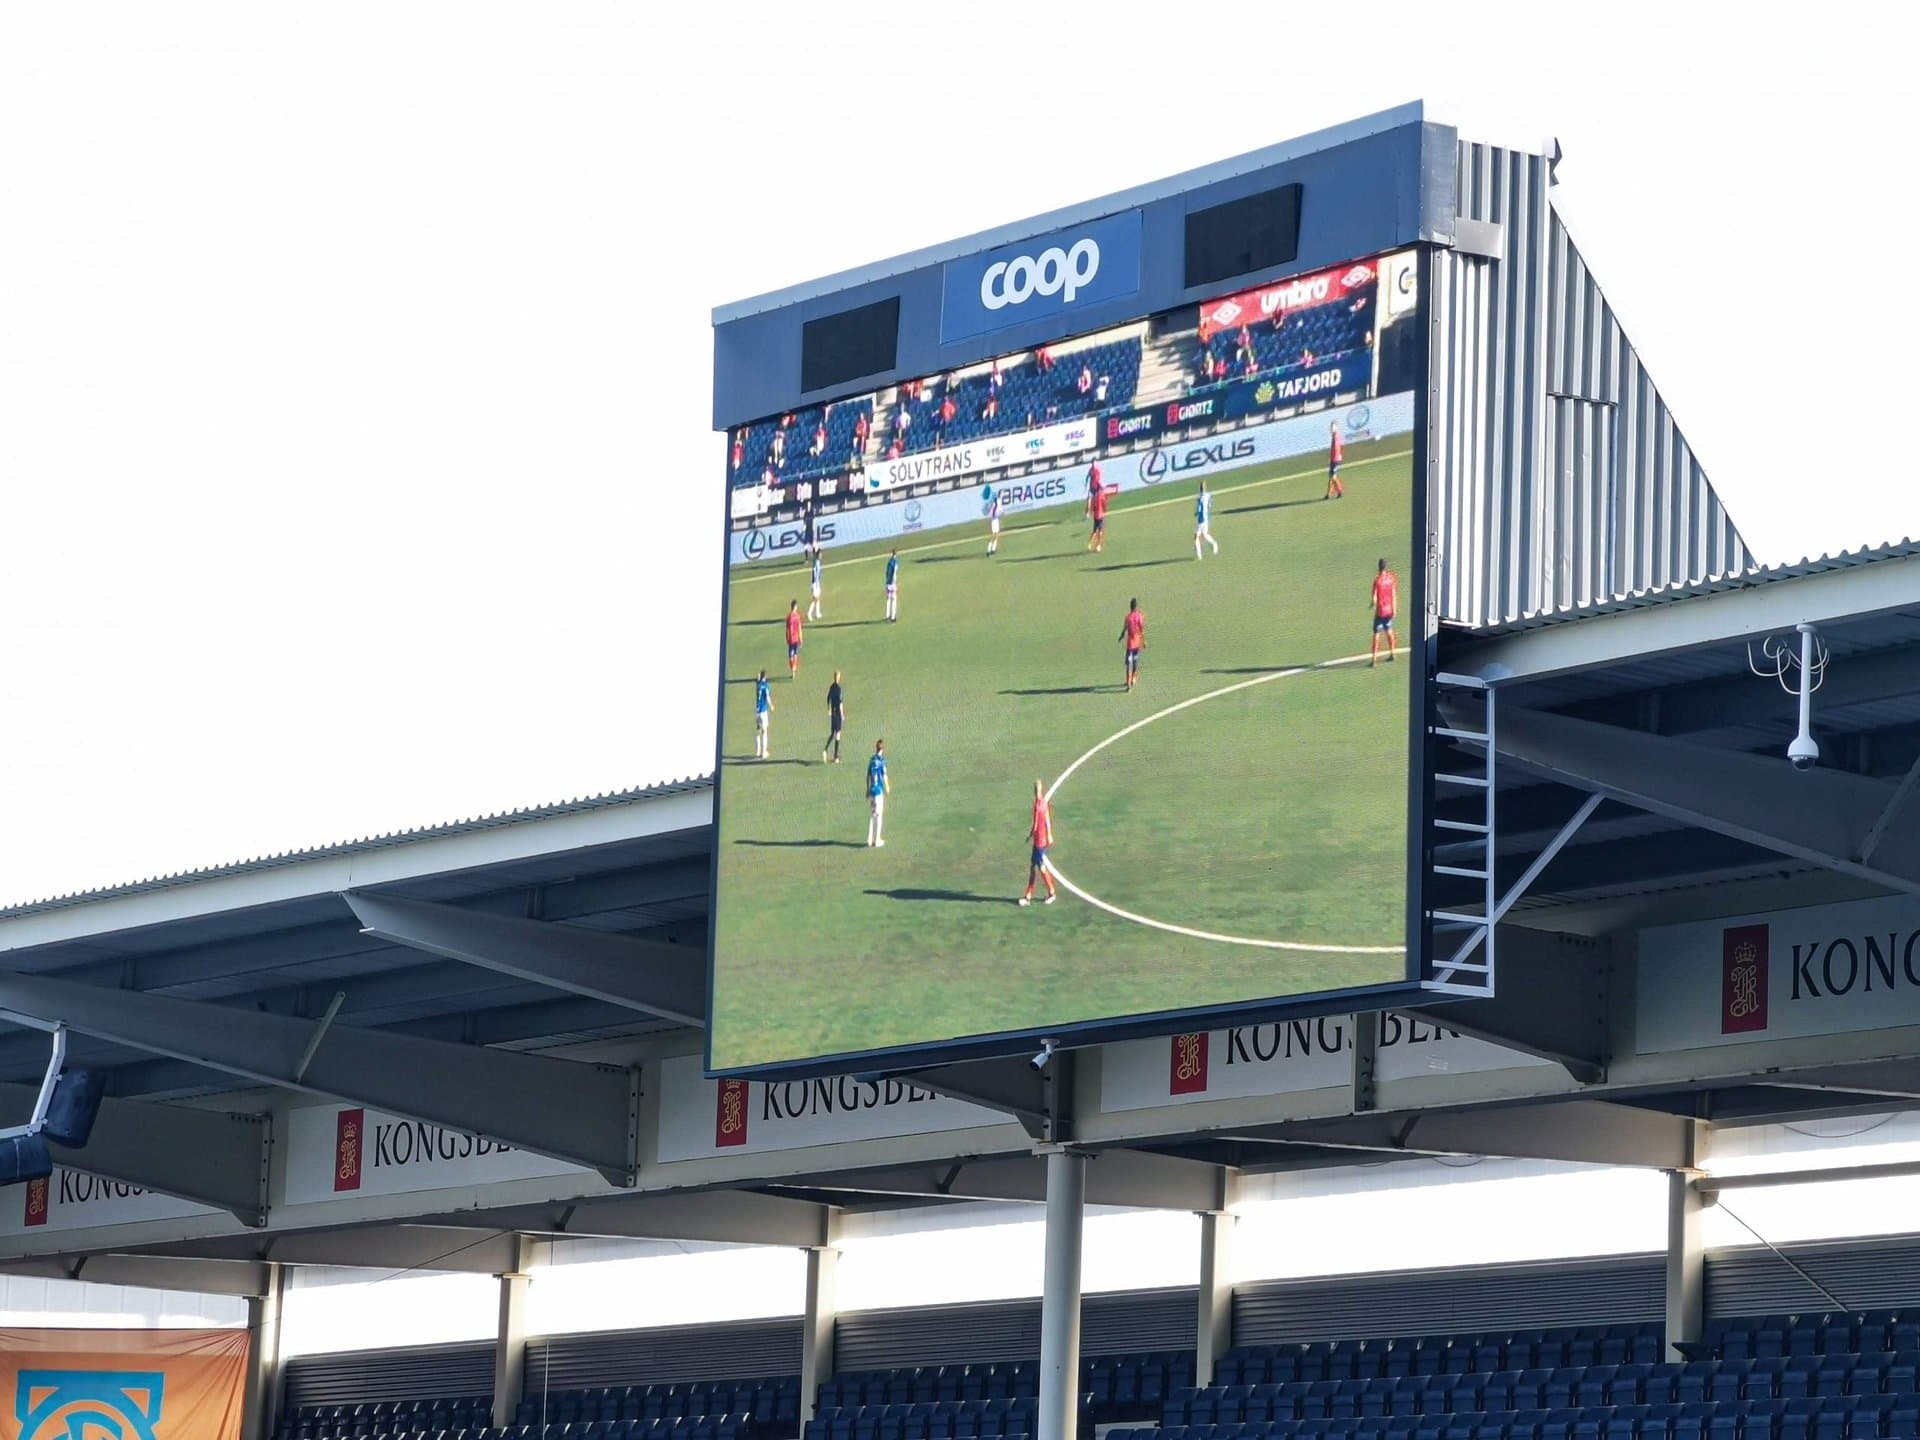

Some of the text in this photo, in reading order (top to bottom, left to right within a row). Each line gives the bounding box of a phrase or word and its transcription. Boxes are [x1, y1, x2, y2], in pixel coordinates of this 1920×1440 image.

[981, 238, 1100, 310] coop
[1261, 278, 1330, 314] umbro
[1277, 368, 1342, 399] TAFJORD
[1171, 437, 1256, 472] LEXUS
[1226, 1011, 1462, 1065] KONGB
[763, 1075, 946, 1121] KONGSB
